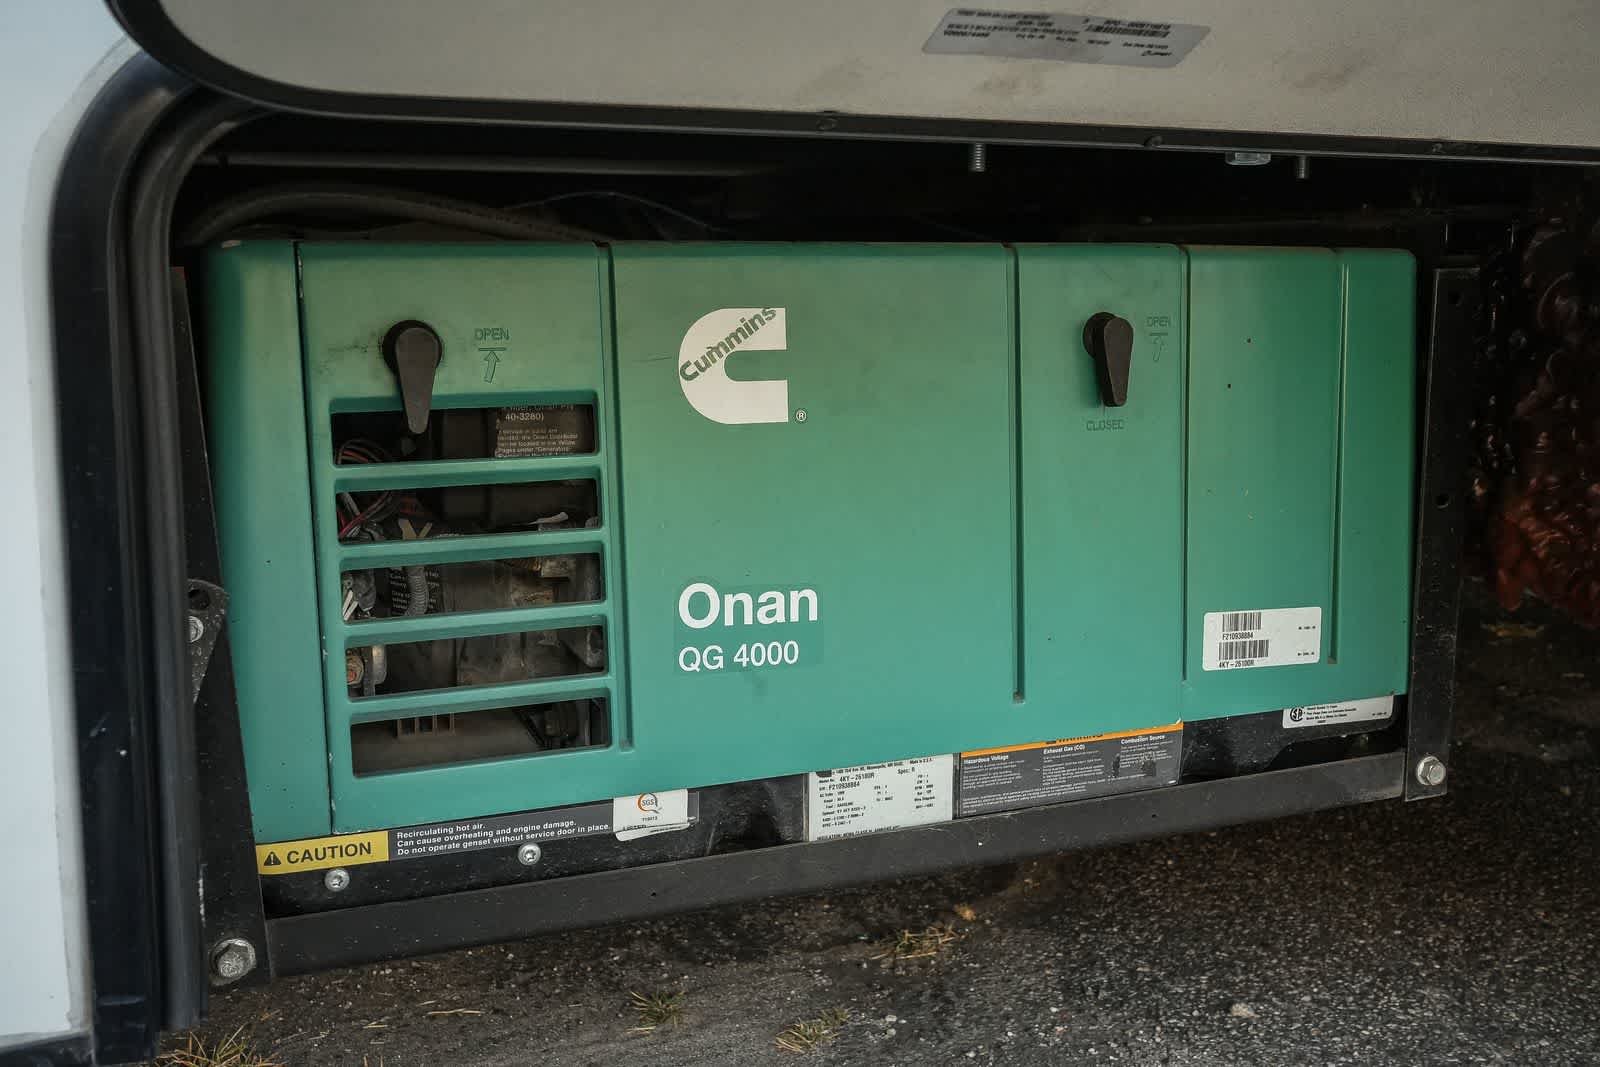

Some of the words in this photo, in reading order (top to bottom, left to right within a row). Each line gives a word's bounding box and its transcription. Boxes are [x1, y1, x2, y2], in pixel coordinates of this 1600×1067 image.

[474, 327, 510, 341] OPEN
[680, 307, 777, 382] Cummins
[1086, 418, 1125, 432] CLOSED
[678, 582, 818, 629] Onan
[678, 645, 724, 672] QG
[733, 640, 800, 668] 4000
[1120, 736, 1149, 745] Combustion
[1043, 747, 1063, 755] Exhaust
[964, 757, 990, 765] Hazardous
[990, 754, 1009, 762] Voltage
[641, 799, 655, 807] SGS
[397, 826, 454, 839] Recirculating
[456, 824, 470, 832] hot
[397, 840, 414, 848] Can
[416, 836, 442, 845] cause
[444, 830, 494, 842] overheating
[495, 827, 512, 835] and
[513, 824, 541, 833] engine
[543, 819, 577, 830] damage.
[397, 848, 410, 856] Do
[411, 846, 426, 854] not
[428, 842, 461, 852] operate
[462, 838, 491, 848] genset
[492, 834, 524, 844] without
[525, 831, 556, 840] service
[556, 828, 576, 836] door
[286, 841, 372, 864] CAUTION
